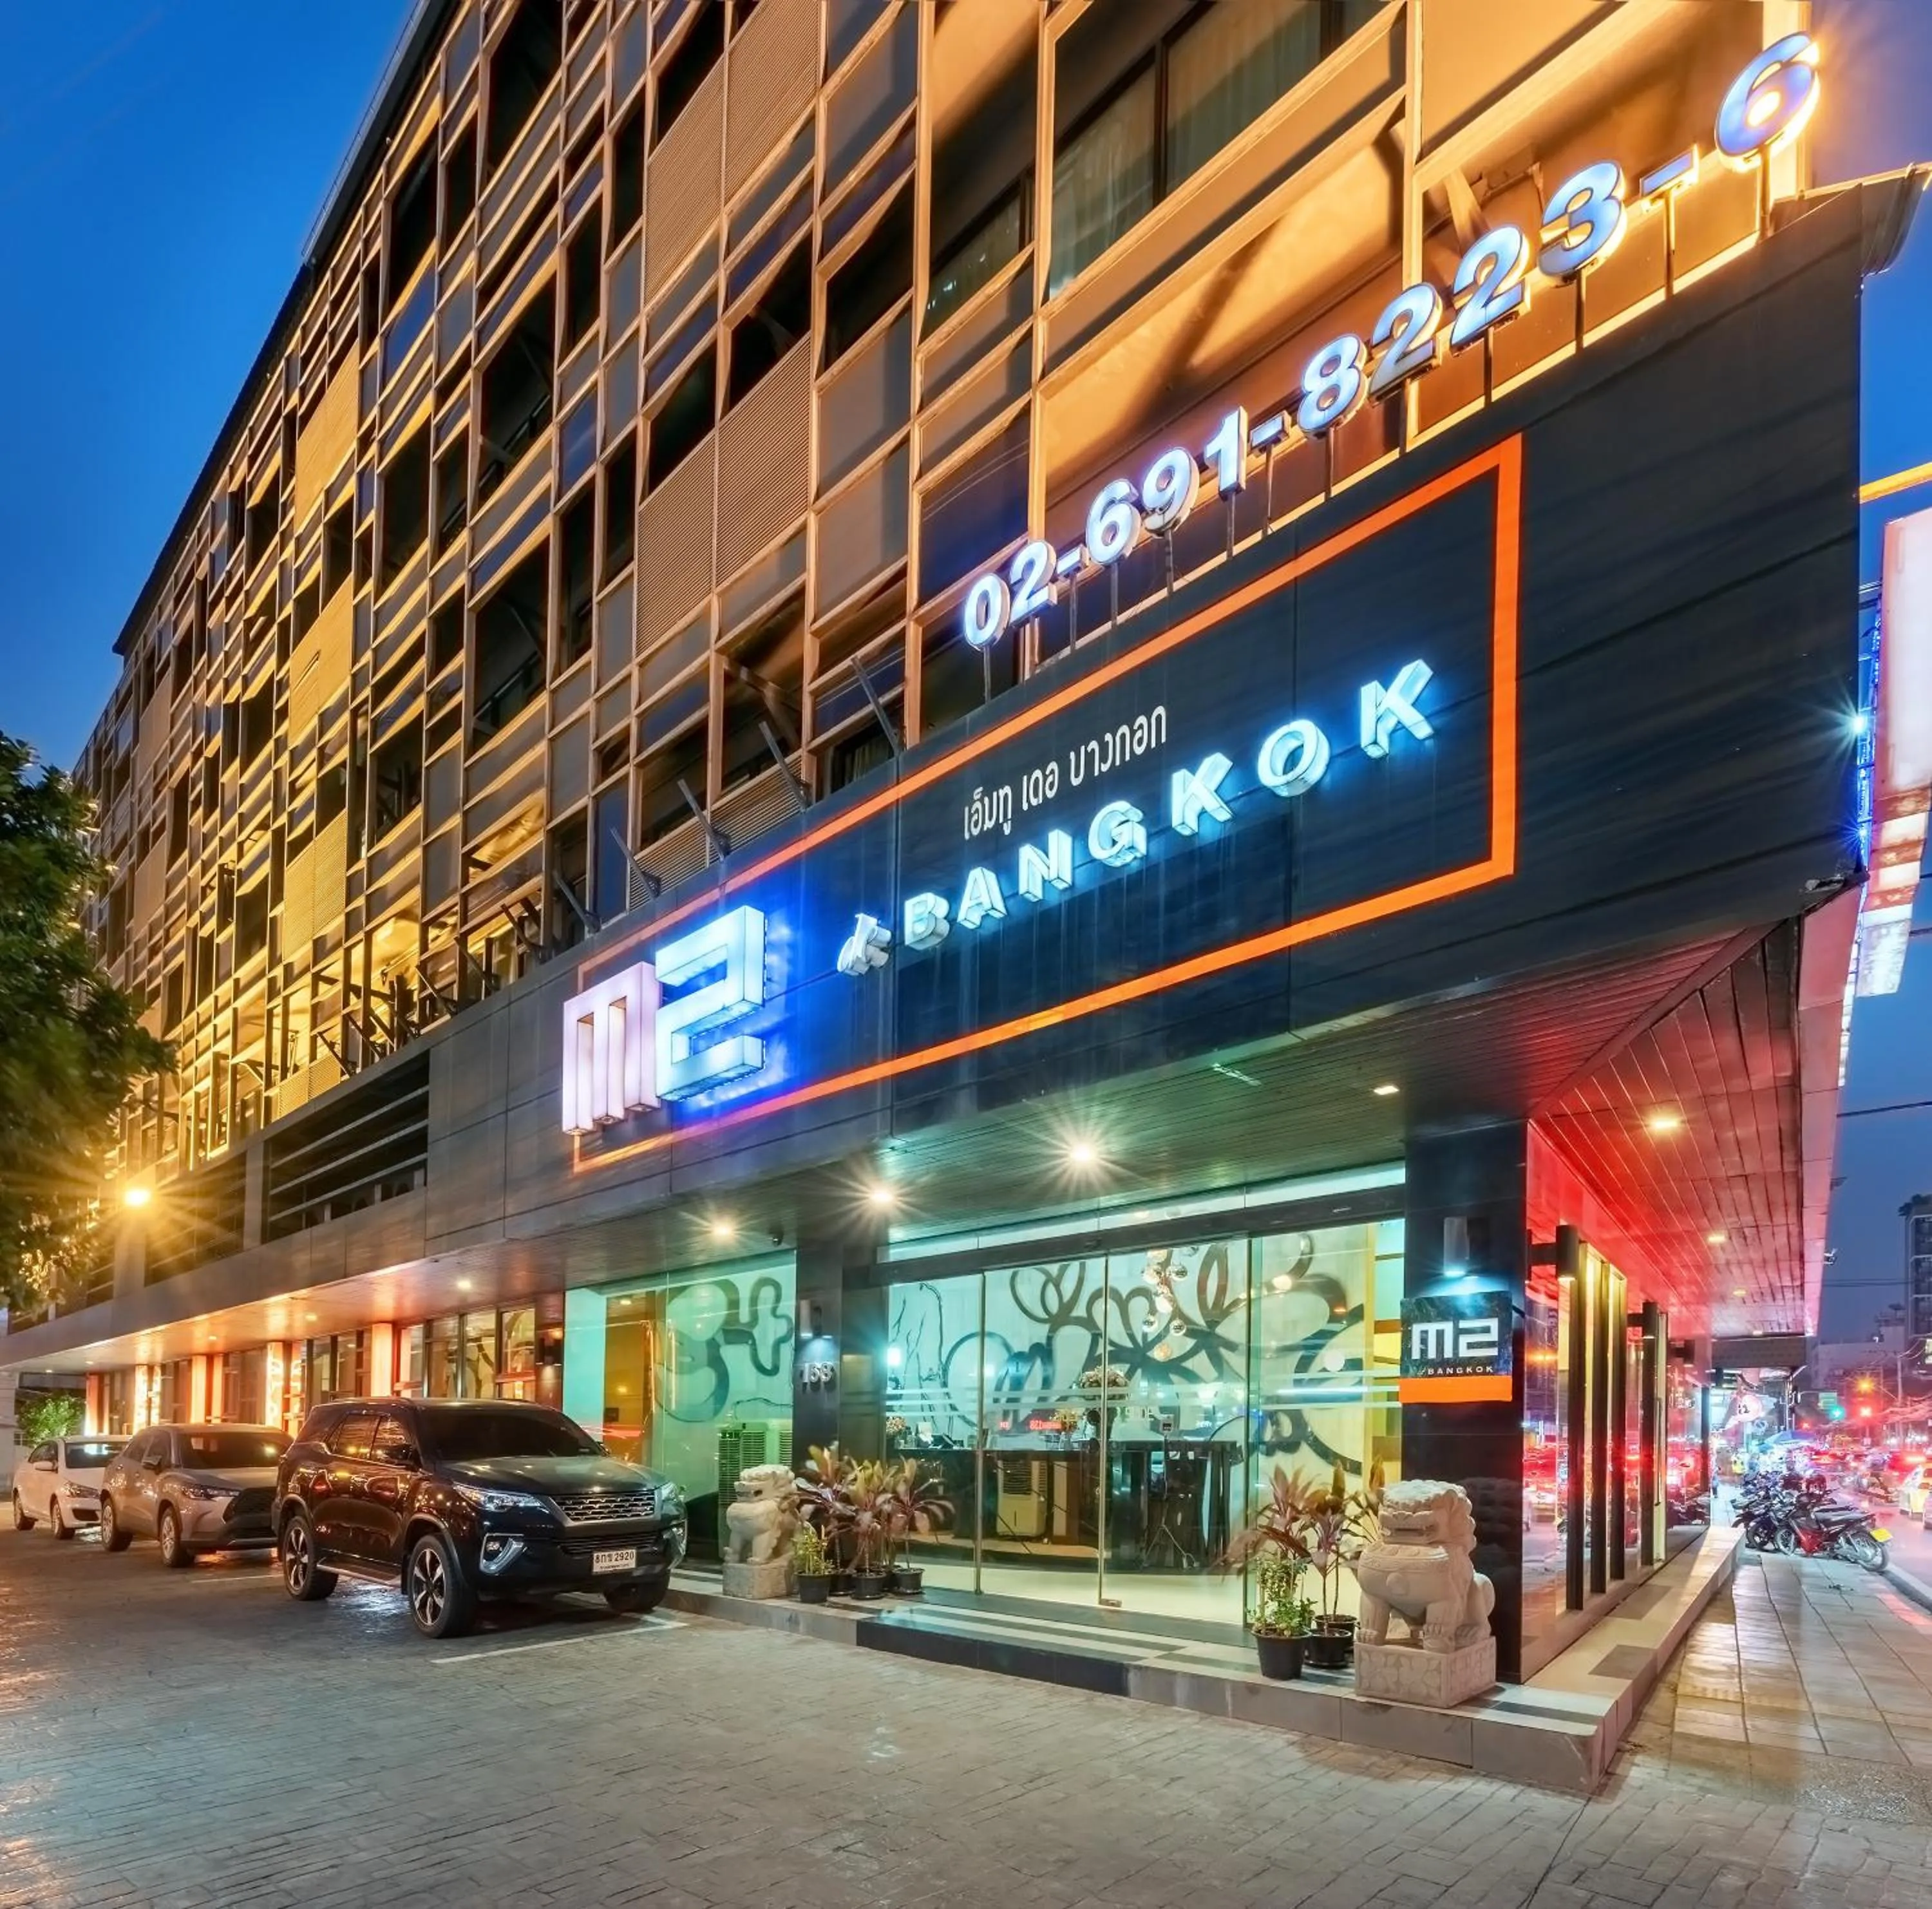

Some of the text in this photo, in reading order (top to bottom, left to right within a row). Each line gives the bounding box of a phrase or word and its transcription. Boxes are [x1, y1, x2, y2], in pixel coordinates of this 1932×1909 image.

[964, 31, 1819, 649] 02-691-8223-6
[904, 659, 1434, 950] BANGKOK
[964, 705, 1167, 840] เอ็มทู เดอ บางกอก
[1428, 1366, 1493, 1375] BANGKOK
[614, 1550, 634, 1561] 2920
